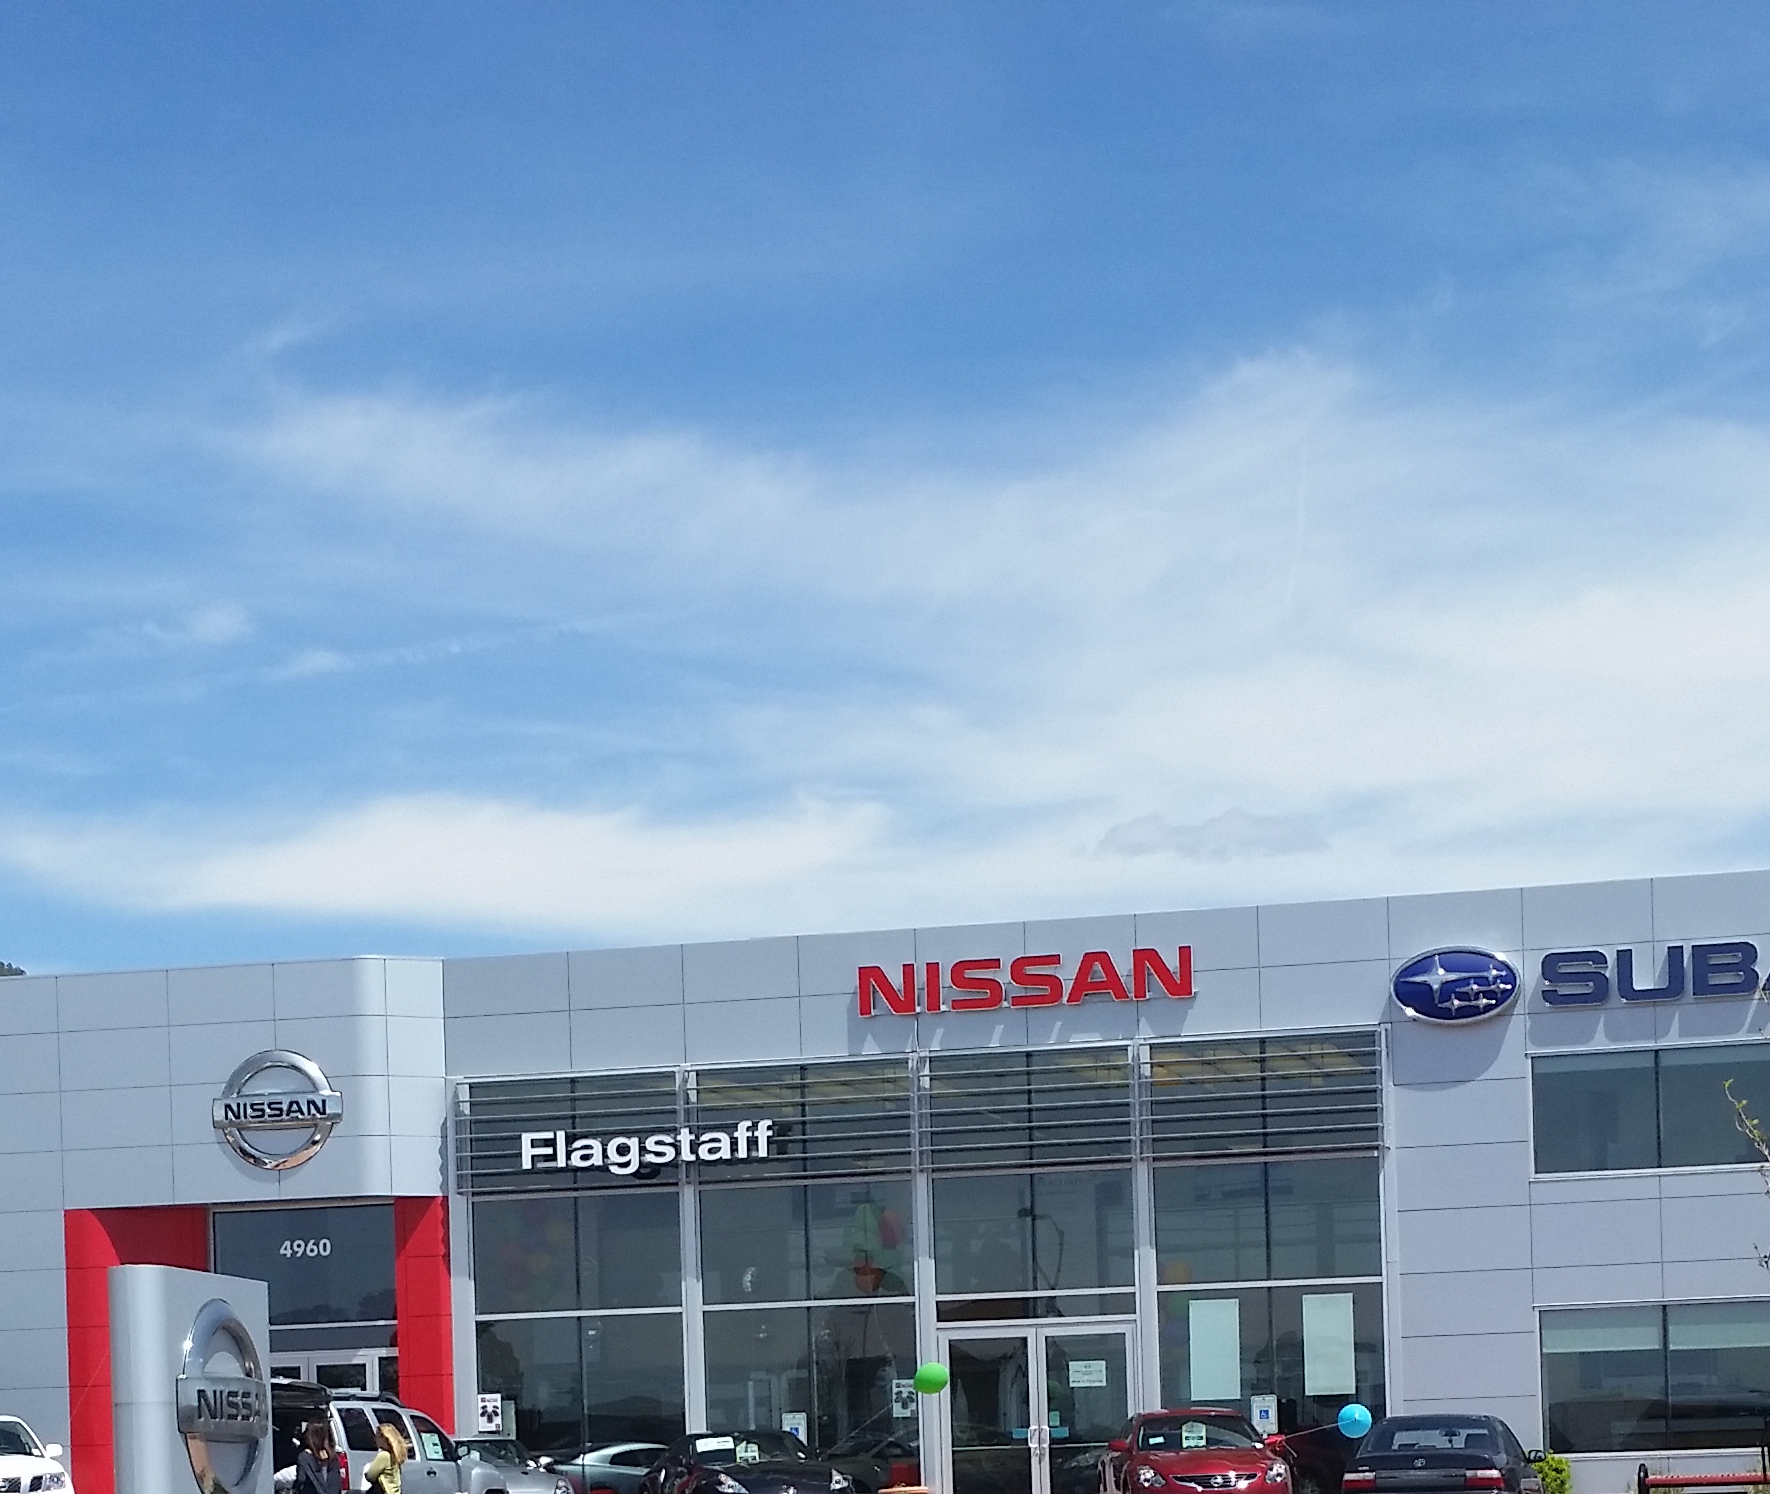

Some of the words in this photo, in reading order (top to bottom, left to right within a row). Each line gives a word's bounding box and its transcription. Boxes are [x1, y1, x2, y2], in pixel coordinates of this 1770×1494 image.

[856, 944, 1195, 1018] NISSAN
[224, 1099, 327, 1121] NISSAN
[521, 1119, 773, 1175] Flagstaff
[279, 1238, 332, 1258] 4960
